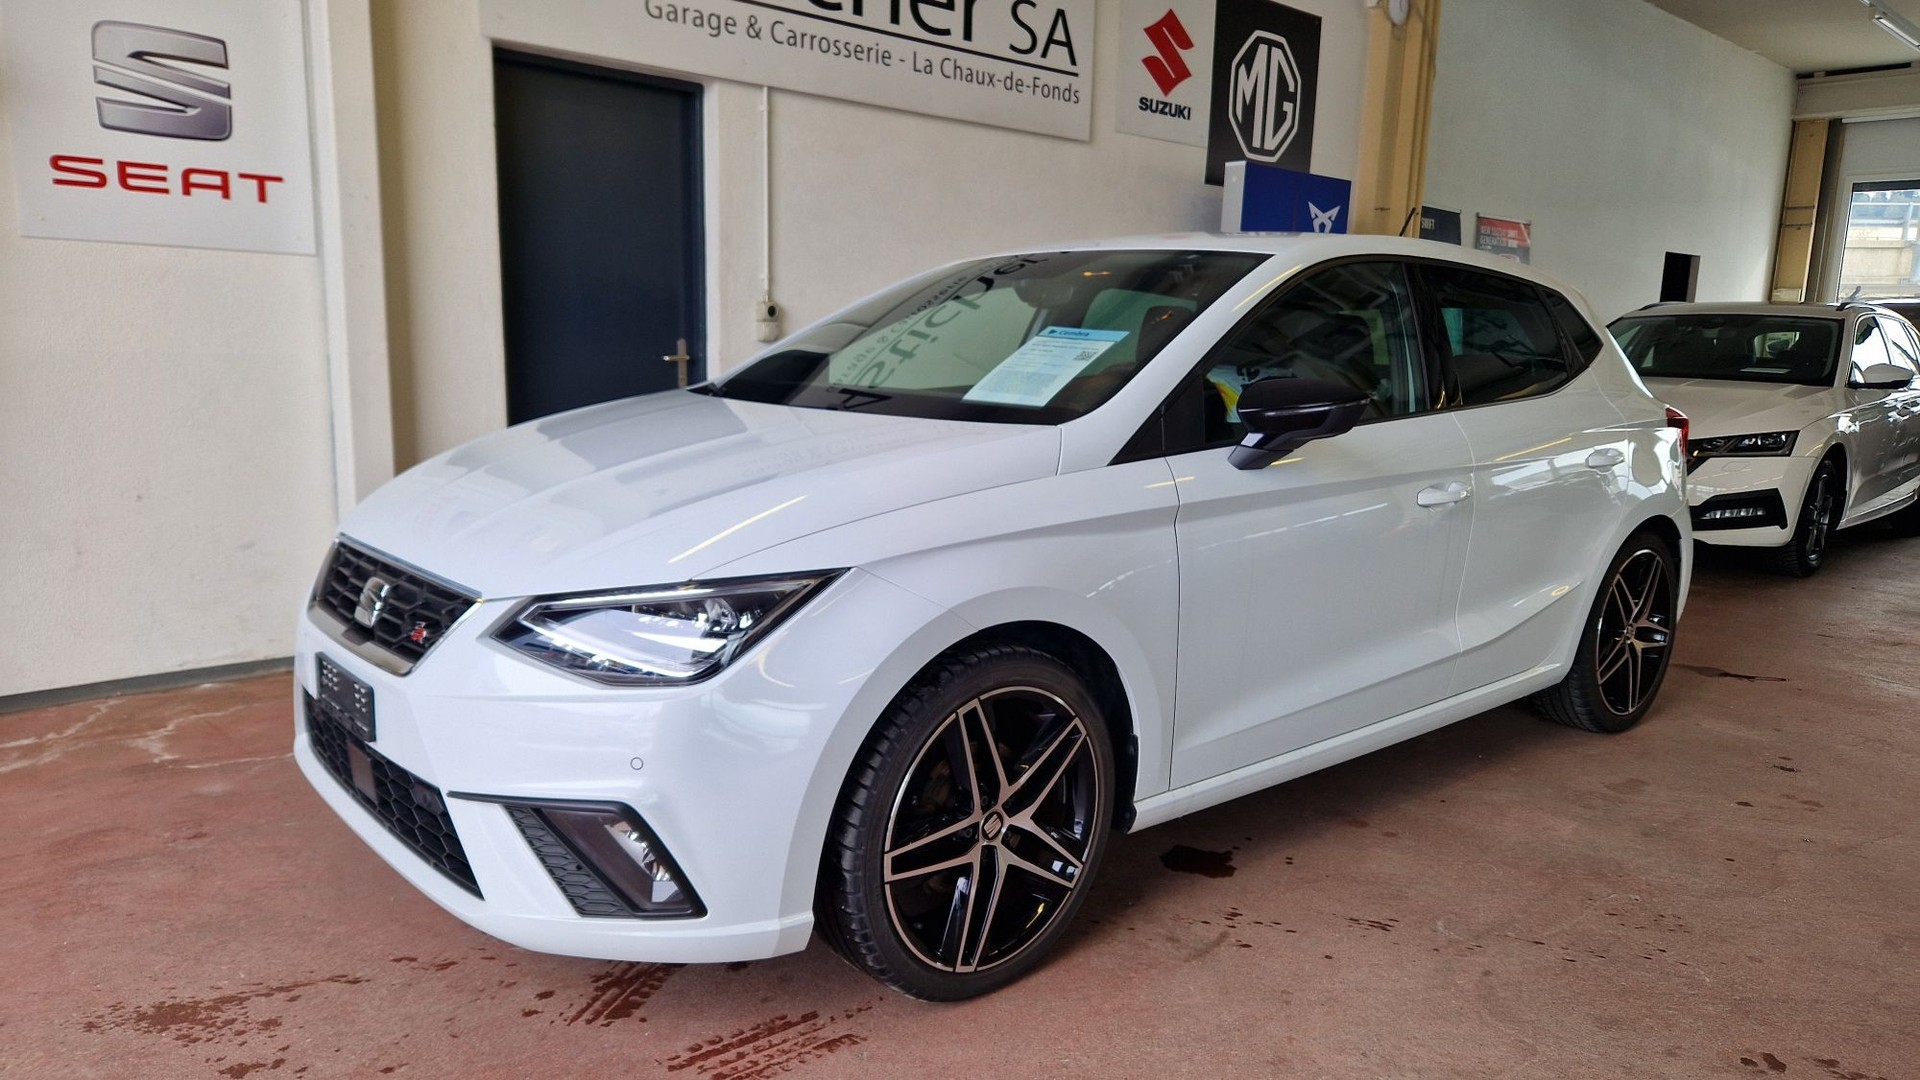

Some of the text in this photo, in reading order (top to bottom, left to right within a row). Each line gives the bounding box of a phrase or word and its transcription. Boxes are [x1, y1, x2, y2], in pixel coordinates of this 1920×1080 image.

[645, 0, 738, 37] Garage
[745, 14, 762, 40] &
[770, 20, 892, 67] Carrosserie
[913, 50, 934, 76] La
[940, 57, 1080, 104] Chaux-de-Fonds
[1009, 0, 1077, 66] SA
[1138, 96, 1191, 121] SUZUKI
[1236, 43, 1295, 150] MG
[49, 154, 285, 204] SEAT
